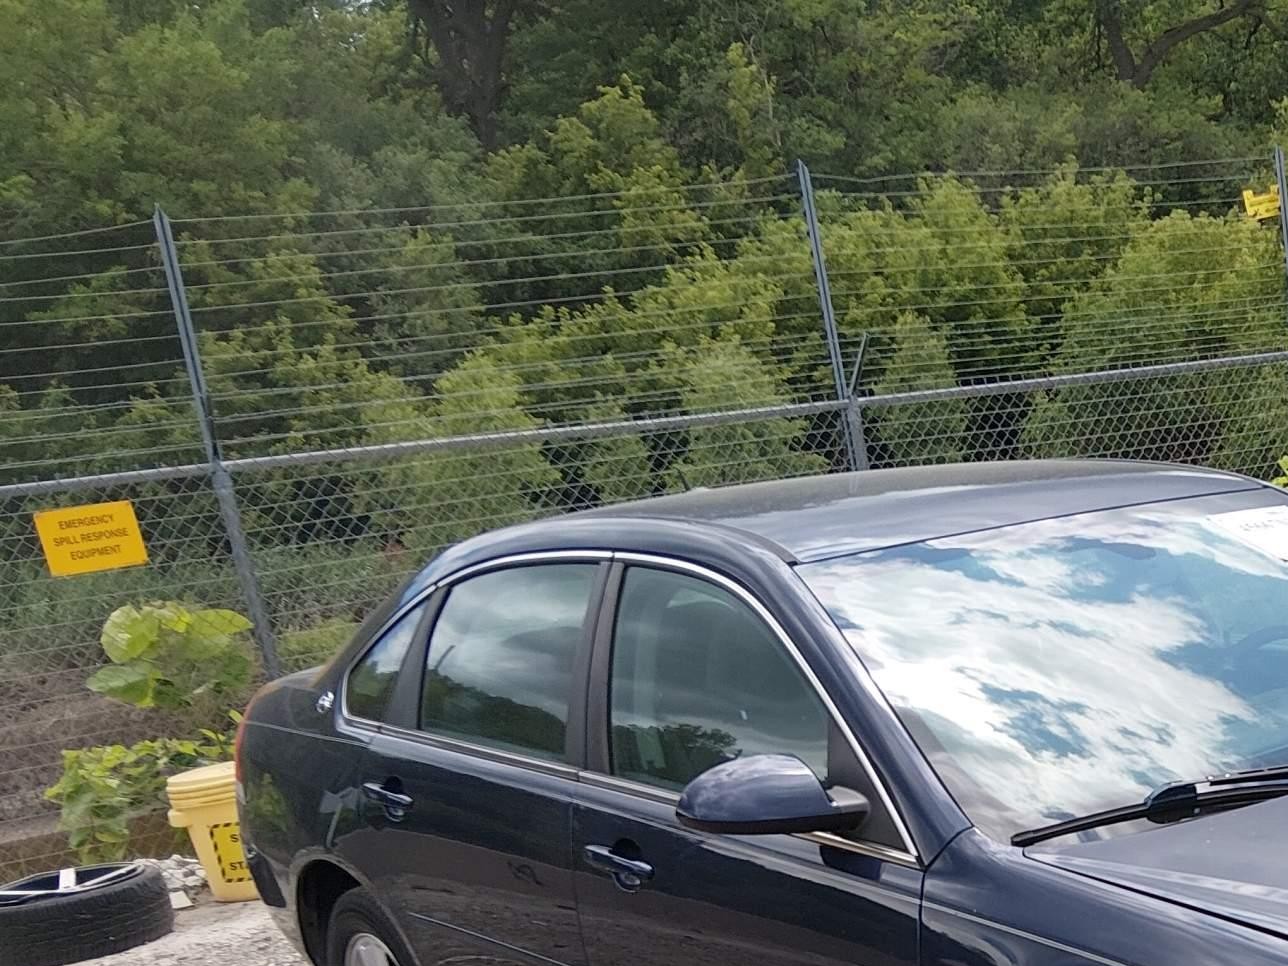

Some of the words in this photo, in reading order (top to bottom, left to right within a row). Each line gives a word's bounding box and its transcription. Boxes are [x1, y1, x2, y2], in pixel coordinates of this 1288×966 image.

[58, 515, 113, 530] EMERGENCY
[54, 536, 80, 547] SPILL
[81, 528, 128, 543] RESPONSE
[71, 546, 120, 560] EQUIPMENT
